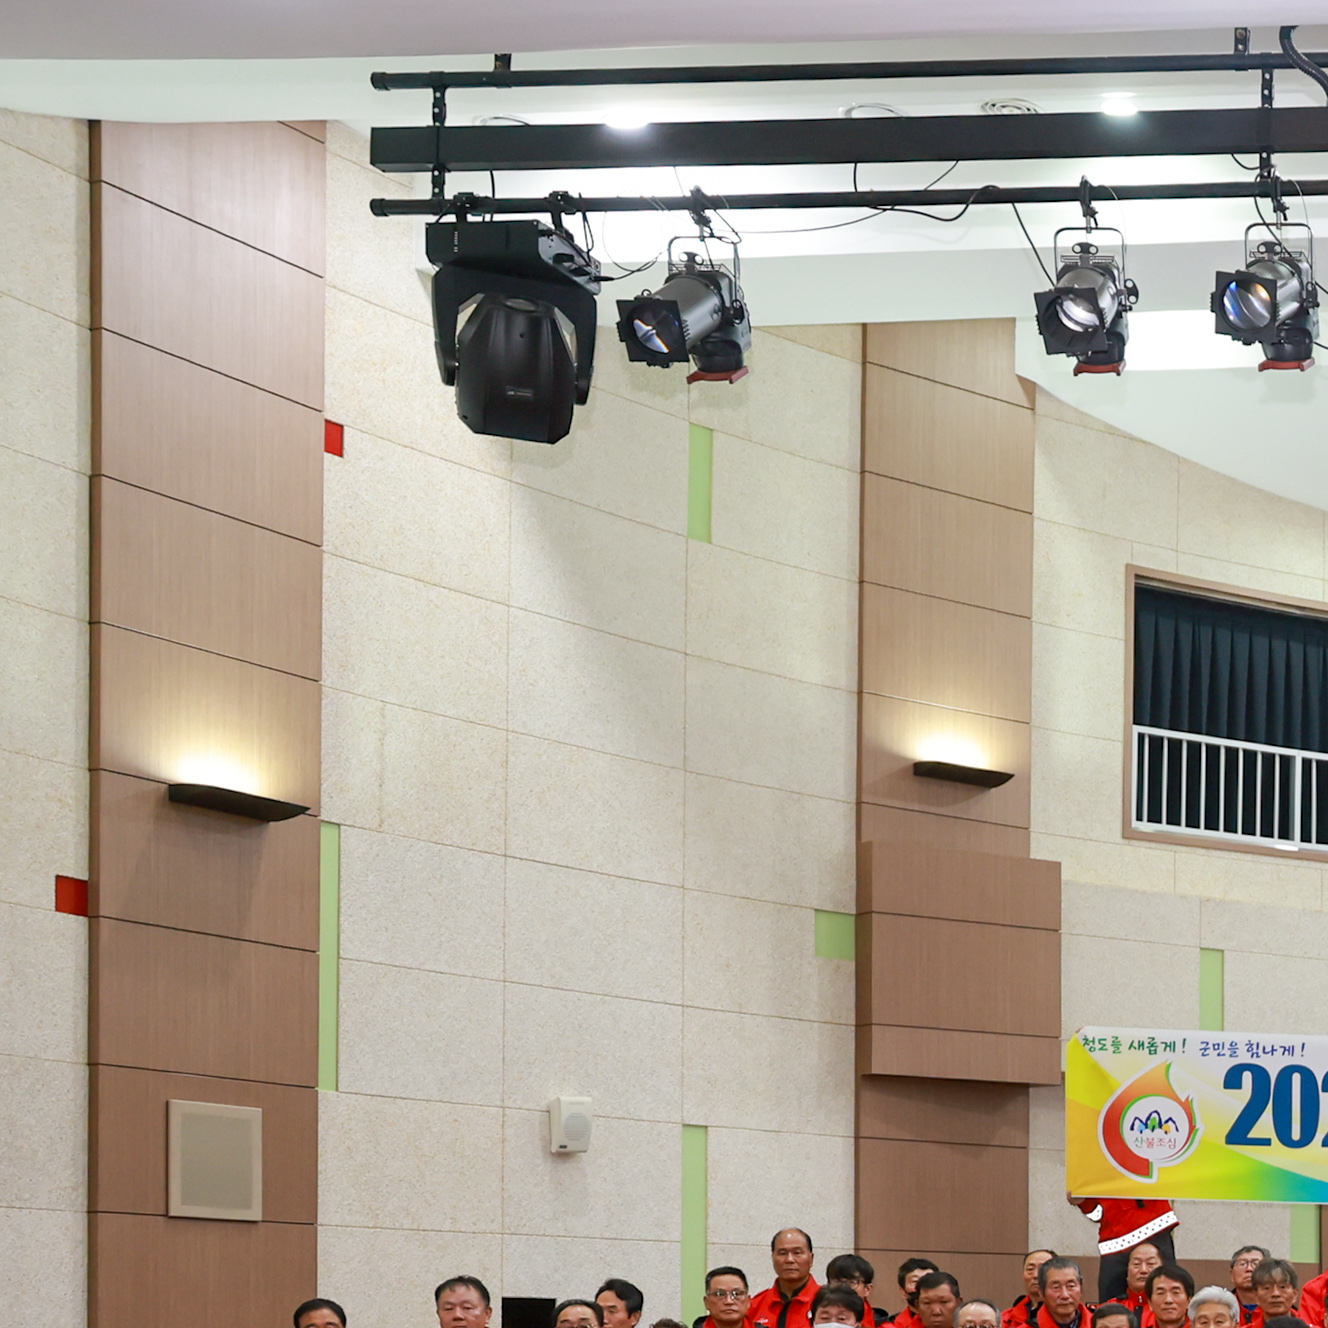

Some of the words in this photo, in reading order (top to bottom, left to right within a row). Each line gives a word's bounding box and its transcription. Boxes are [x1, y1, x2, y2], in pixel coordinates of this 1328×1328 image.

[1081, 1035, 1122, 1053] 청도를
[1198, 1040, 1240, 1058] 군민을
[1132, 1135, 1178, 1150] 산불조심
